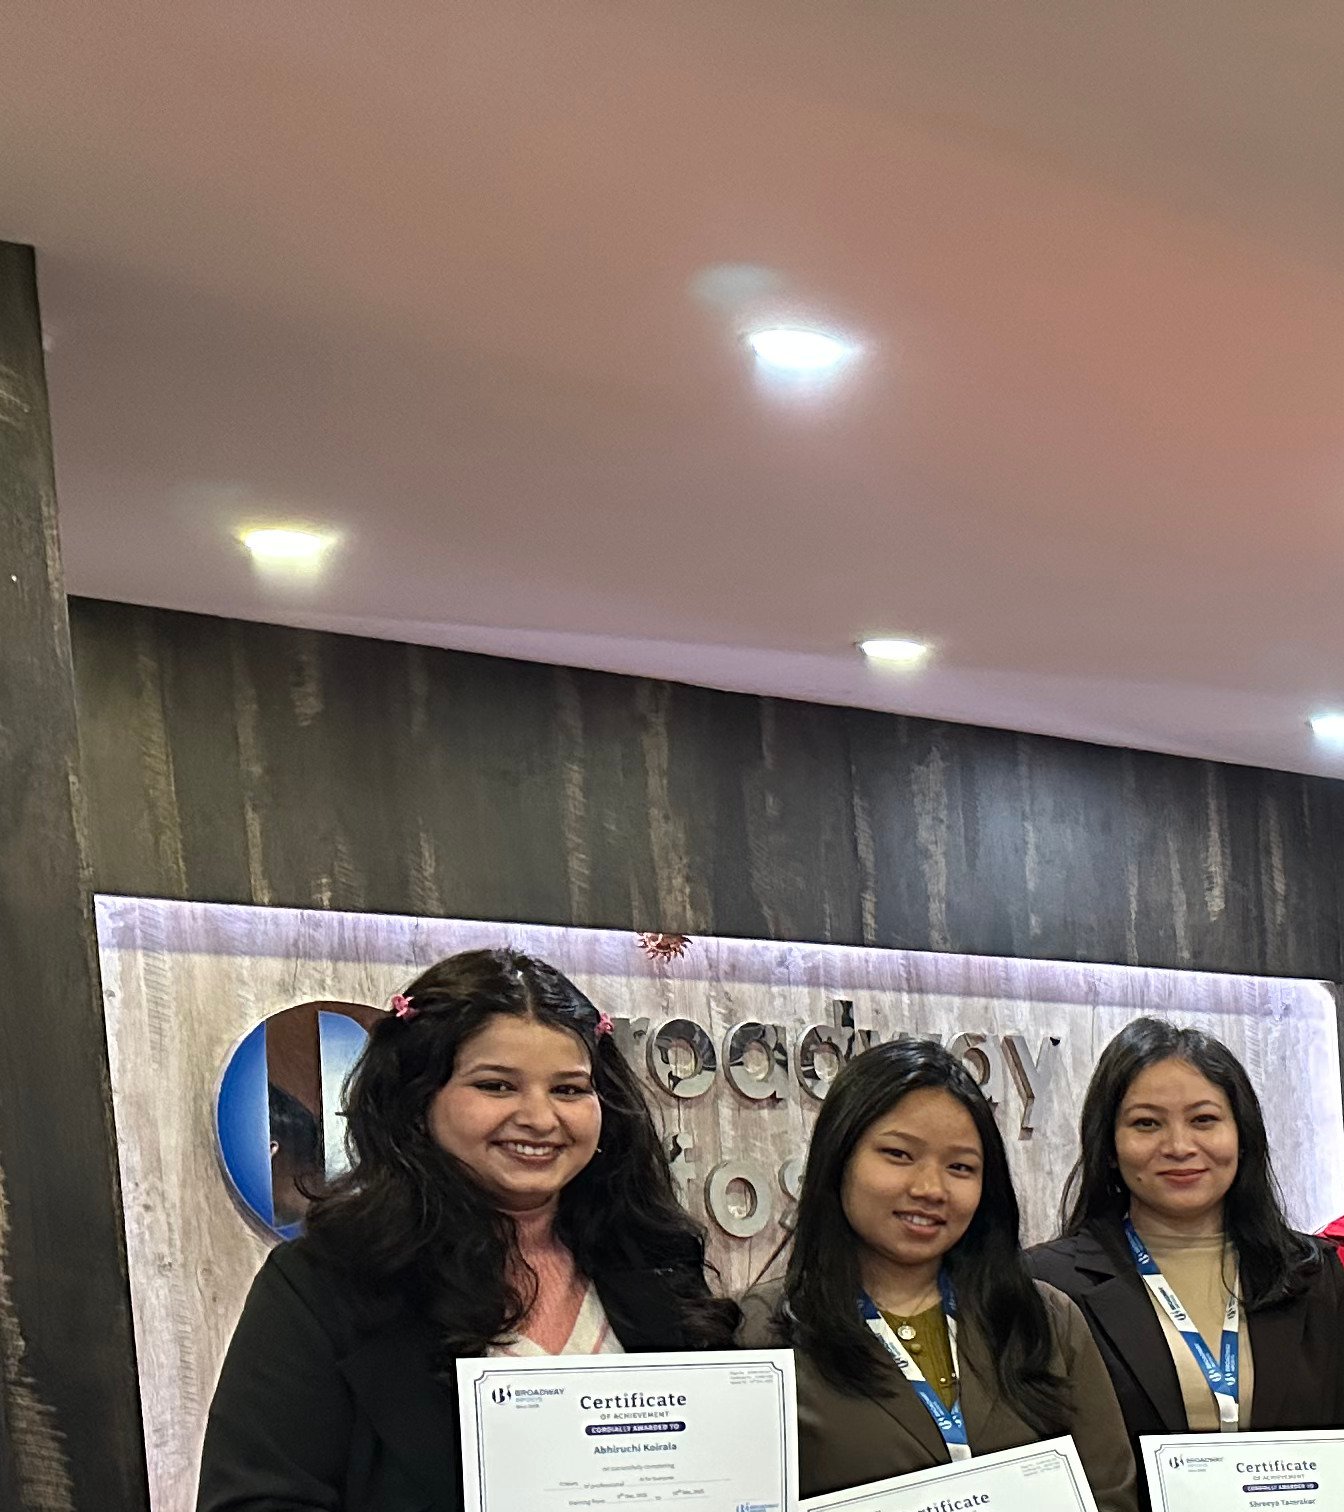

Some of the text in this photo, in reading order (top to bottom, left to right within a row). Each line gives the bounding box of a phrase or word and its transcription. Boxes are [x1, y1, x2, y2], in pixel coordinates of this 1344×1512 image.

[515, 1389, 565, 1397] BROADWAY
[580, 1392, 687, 1409] Certificate
[613, 1411, 669, 1419] ACHIEVEMENT
[594, 1442, 677, 1454] Abhiruchi Koirala
[1236, 1460, 1317, 1473] Certificate
